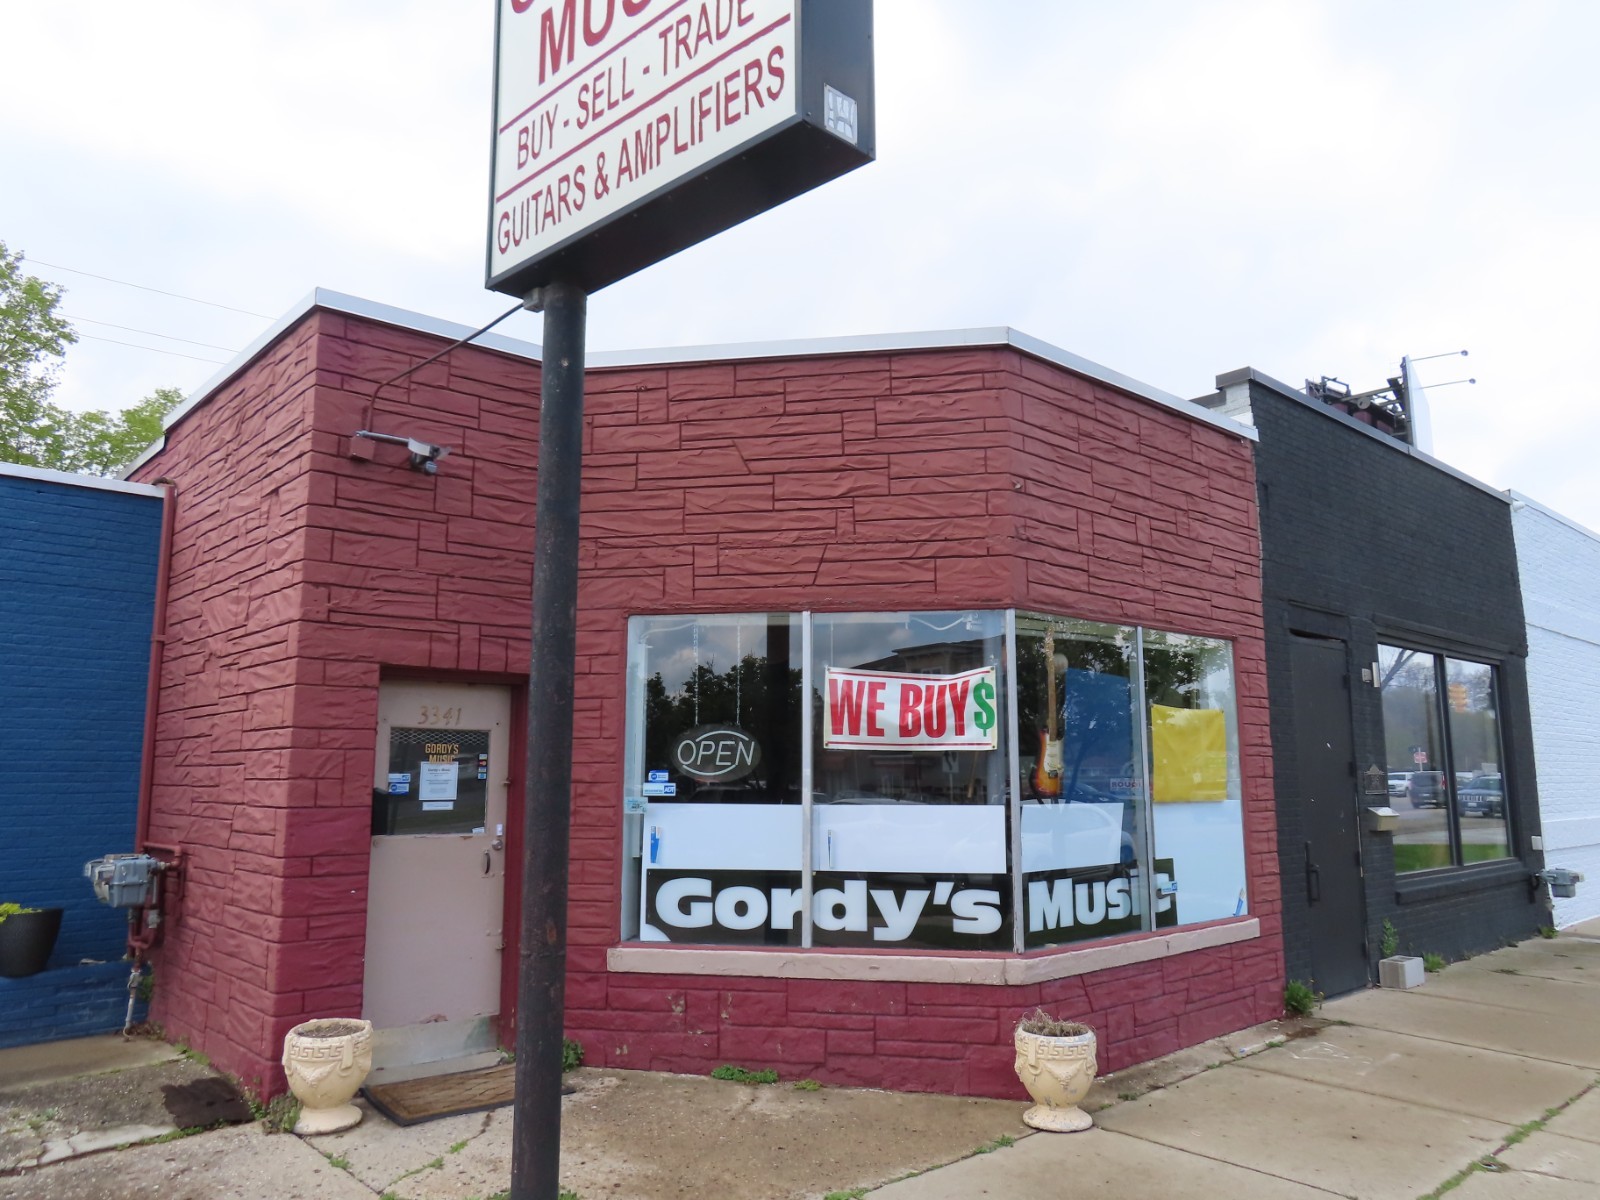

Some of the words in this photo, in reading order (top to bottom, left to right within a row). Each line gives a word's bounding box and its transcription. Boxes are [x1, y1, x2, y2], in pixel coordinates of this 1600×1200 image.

[517, 103, 560, 171] BUY
[575, 57, 635, 131] SELL
[496, 163, 587, 256] GUITARS
[593, 151, 610, 200] &
[615, 45, 786, 190] AMPLIFIERS
[416, 705, 463, 727] 3341
[828, 679, 887, 737] WE
[425, 742, 459, 755] GORDY'S
[676, 739, 755, 767] OPEN
[655, 877, 1003, 942] Gordy's
[1028, 868, 1172, 933] Music
